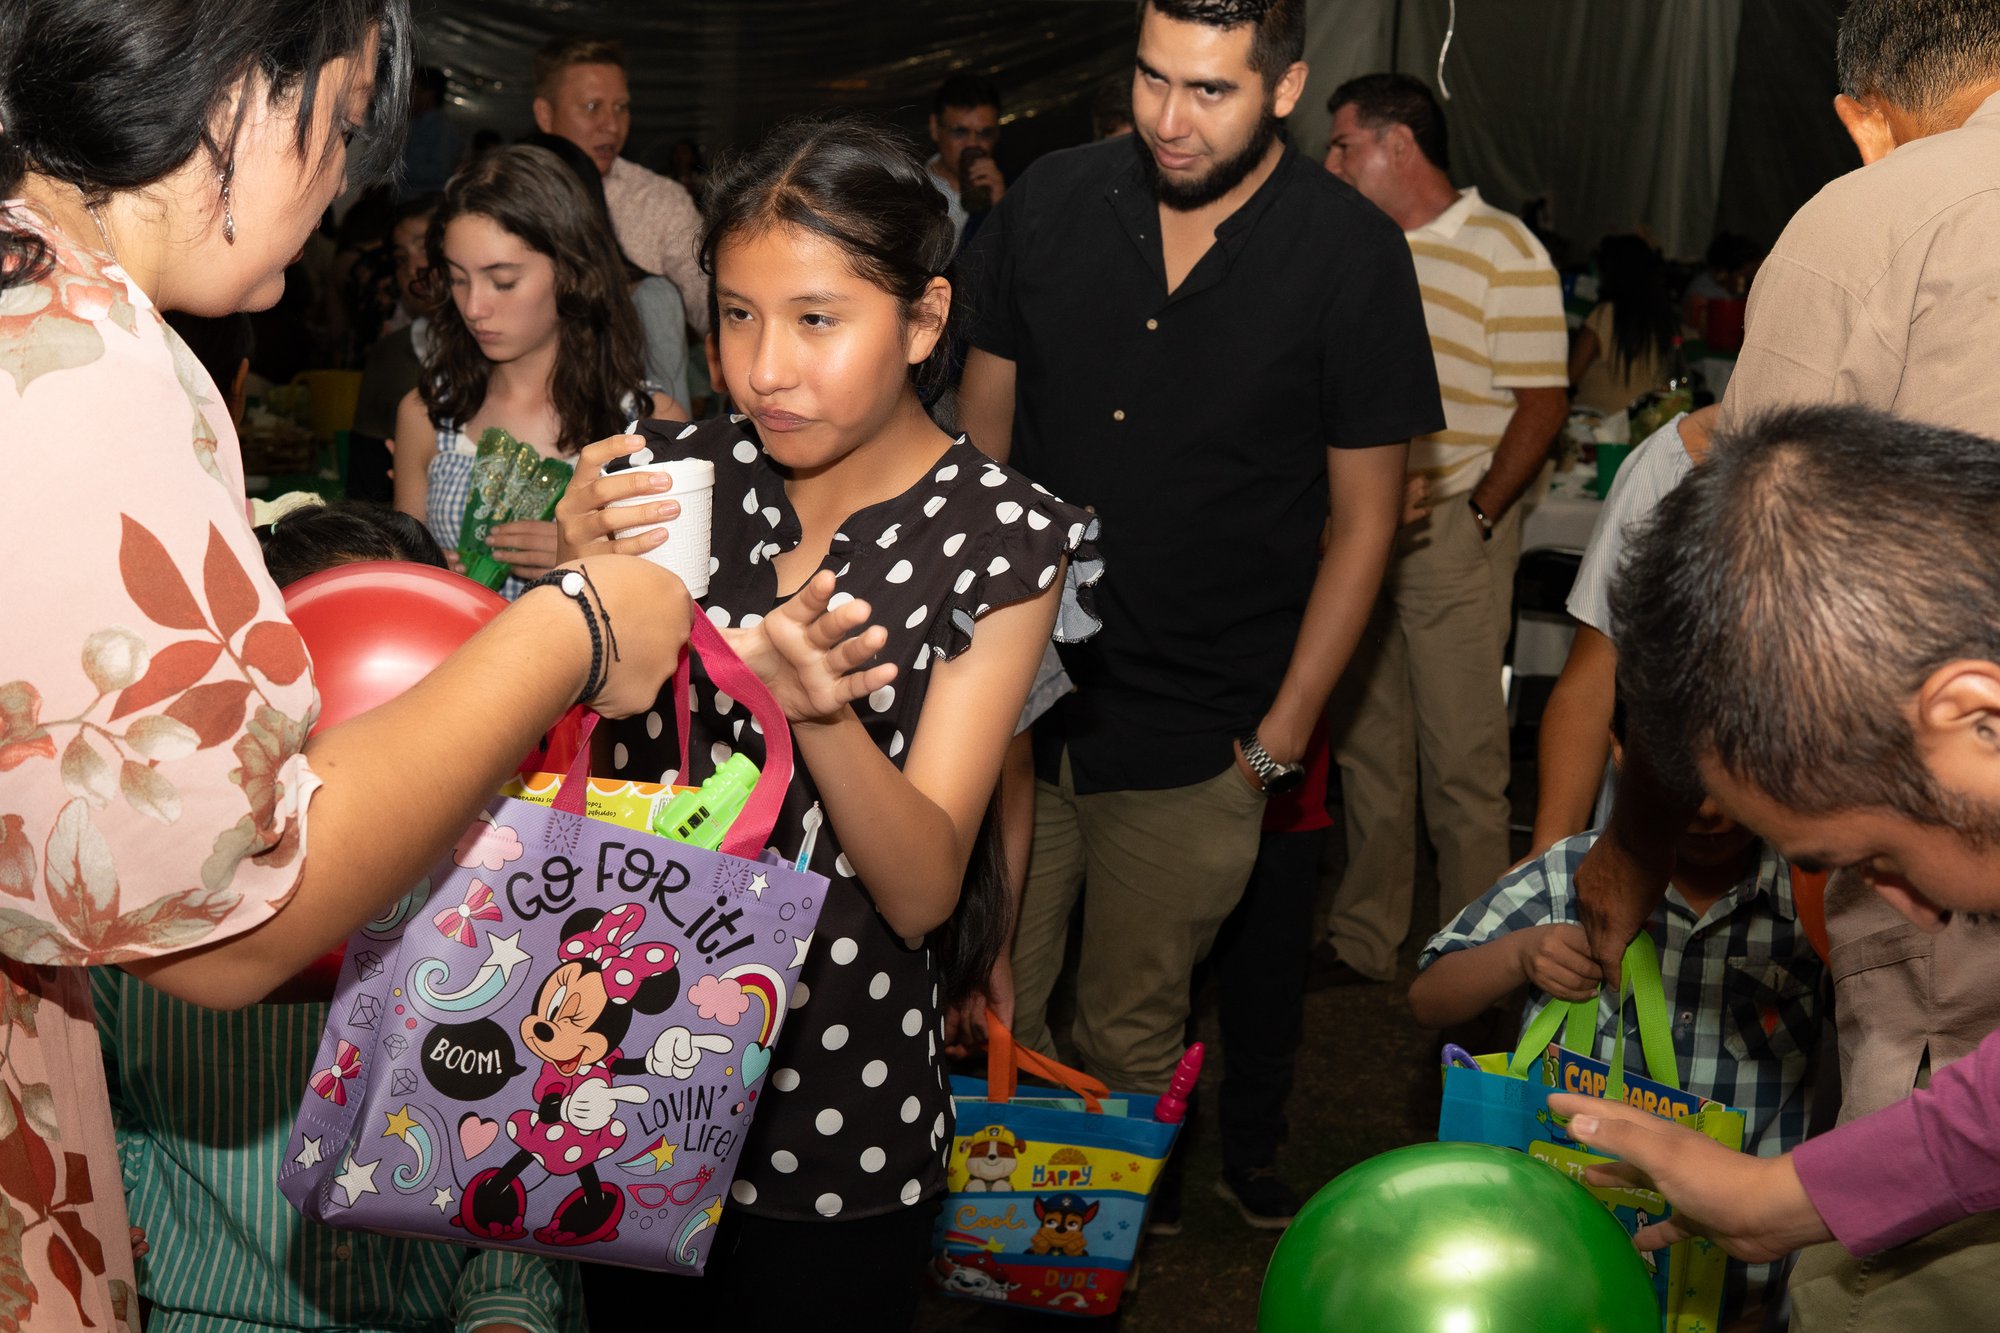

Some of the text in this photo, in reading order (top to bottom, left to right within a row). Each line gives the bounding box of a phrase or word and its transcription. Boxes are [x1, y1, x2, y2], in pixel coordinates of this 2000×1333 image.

[588, 809, 617, 818] Copyright
[505, 841, 755, 965] GO FOR it!
[430, 1037, 503, 1075] BOOM!
[637, 1085, 728, 1136] LOVIN'
[1045, 1269, 1099, 1289] DUDE
